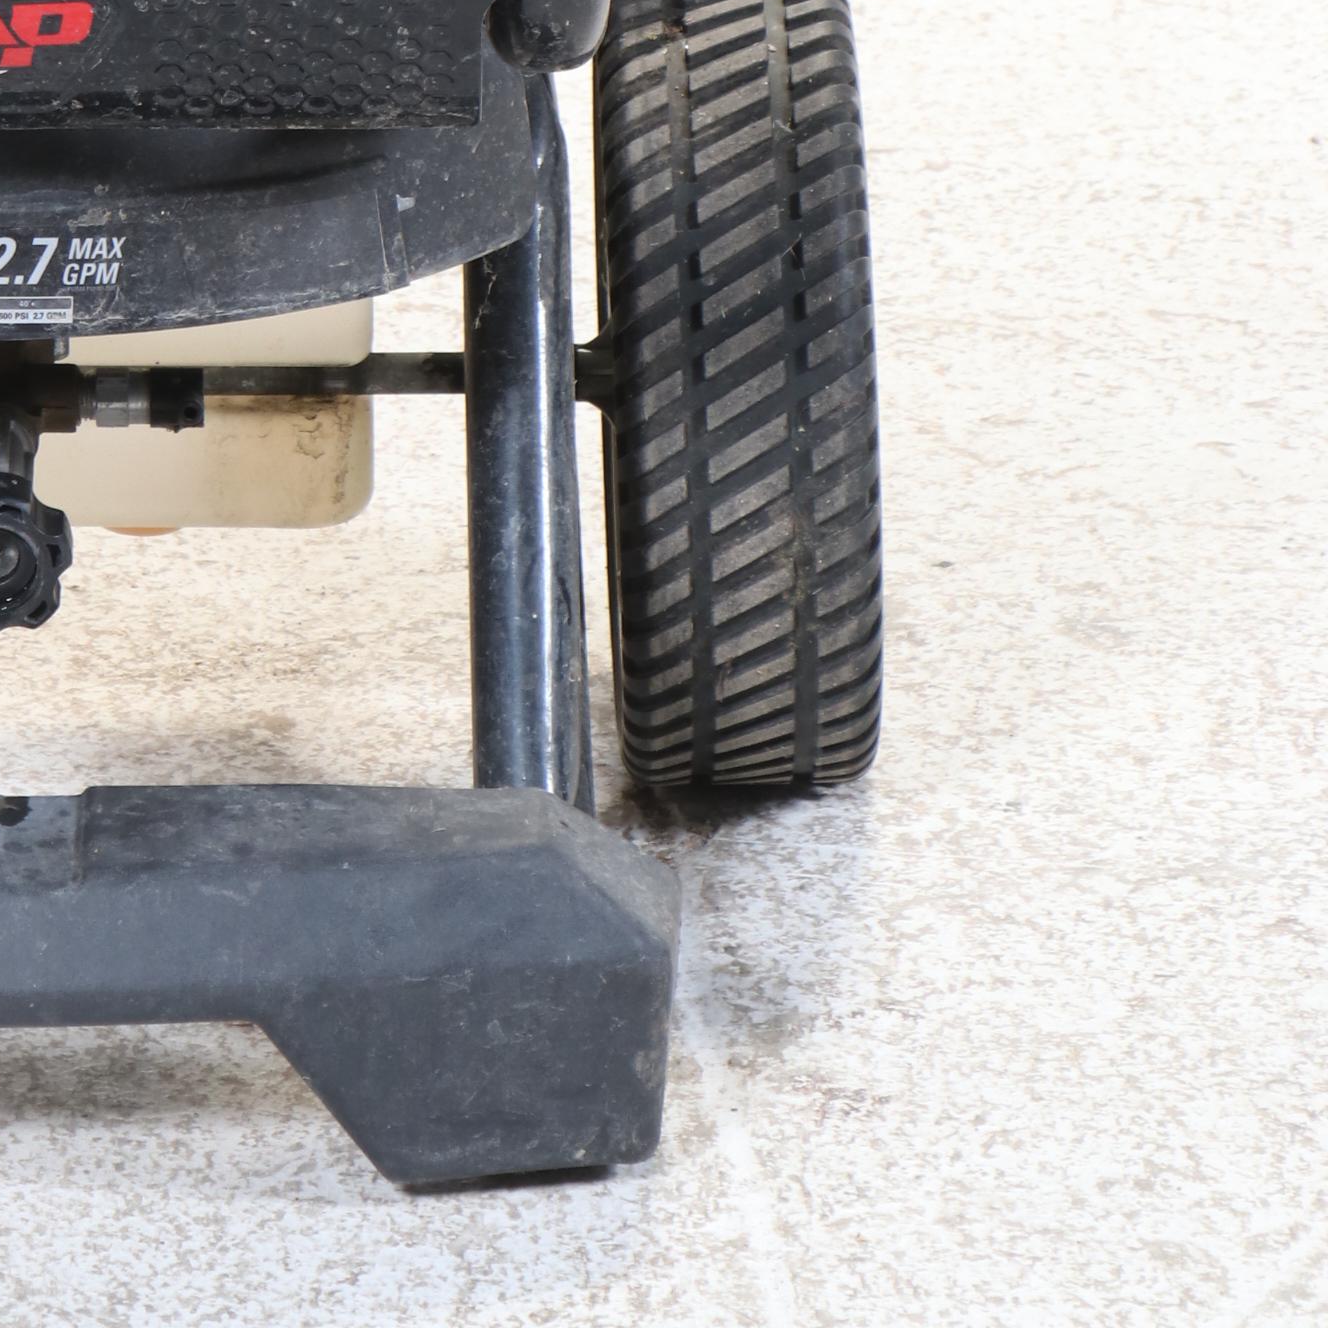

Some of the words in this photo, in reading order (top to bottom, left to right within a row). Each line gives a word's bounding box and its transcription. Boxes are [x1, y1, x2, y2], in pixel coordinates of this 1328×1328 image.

[67, 236, 127, 260] MAX
[62, 262, 120, 286] GPM
[14, 312, 30, 320] PSI
[32, 312, 44, 320] 2.7
